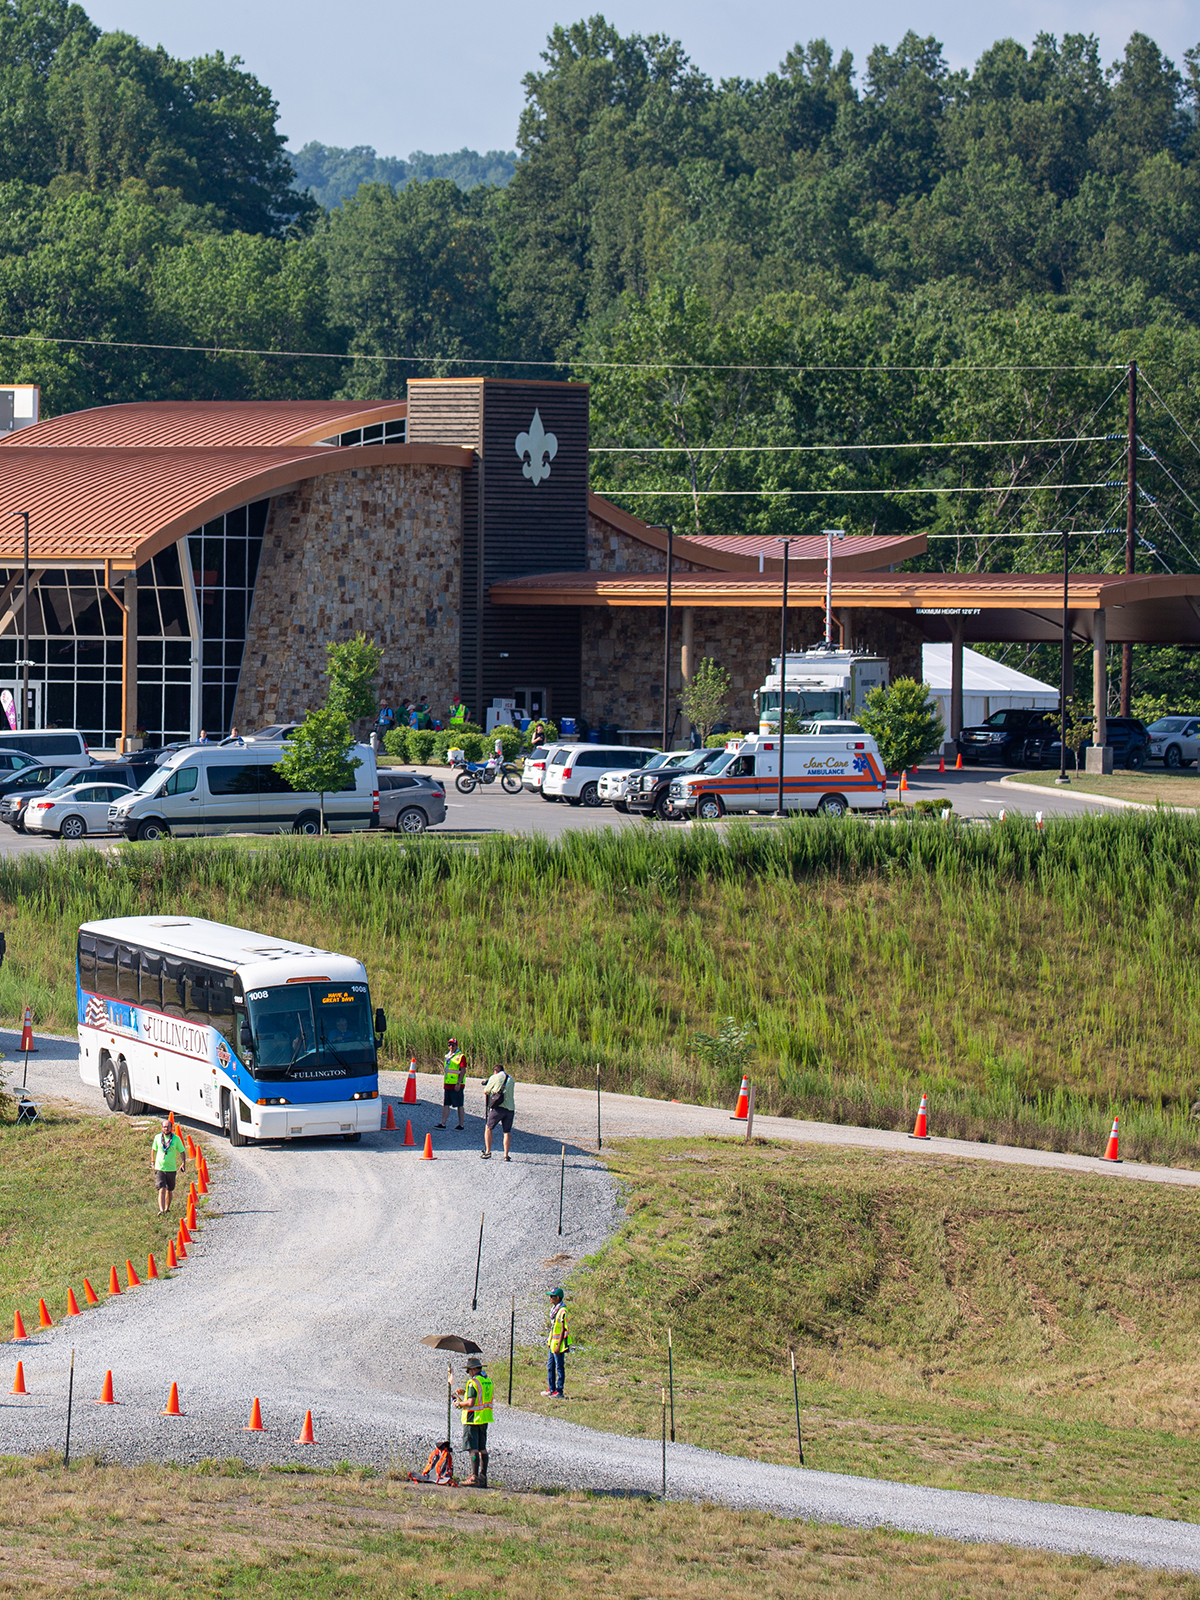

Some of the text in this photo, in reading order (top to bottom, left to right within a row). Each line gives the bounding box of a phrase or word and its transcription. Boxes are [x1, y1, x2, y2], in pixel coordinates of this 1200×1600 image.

[803, 757, 849, 769] Jan-Care
[351, 985, 367, 993] 1008
[249, 990, 269, 1001] 1008
[143, 1016, 209, 1055] FULLINGTON
[290, 1069, 347, 1079] FULLINGTON
